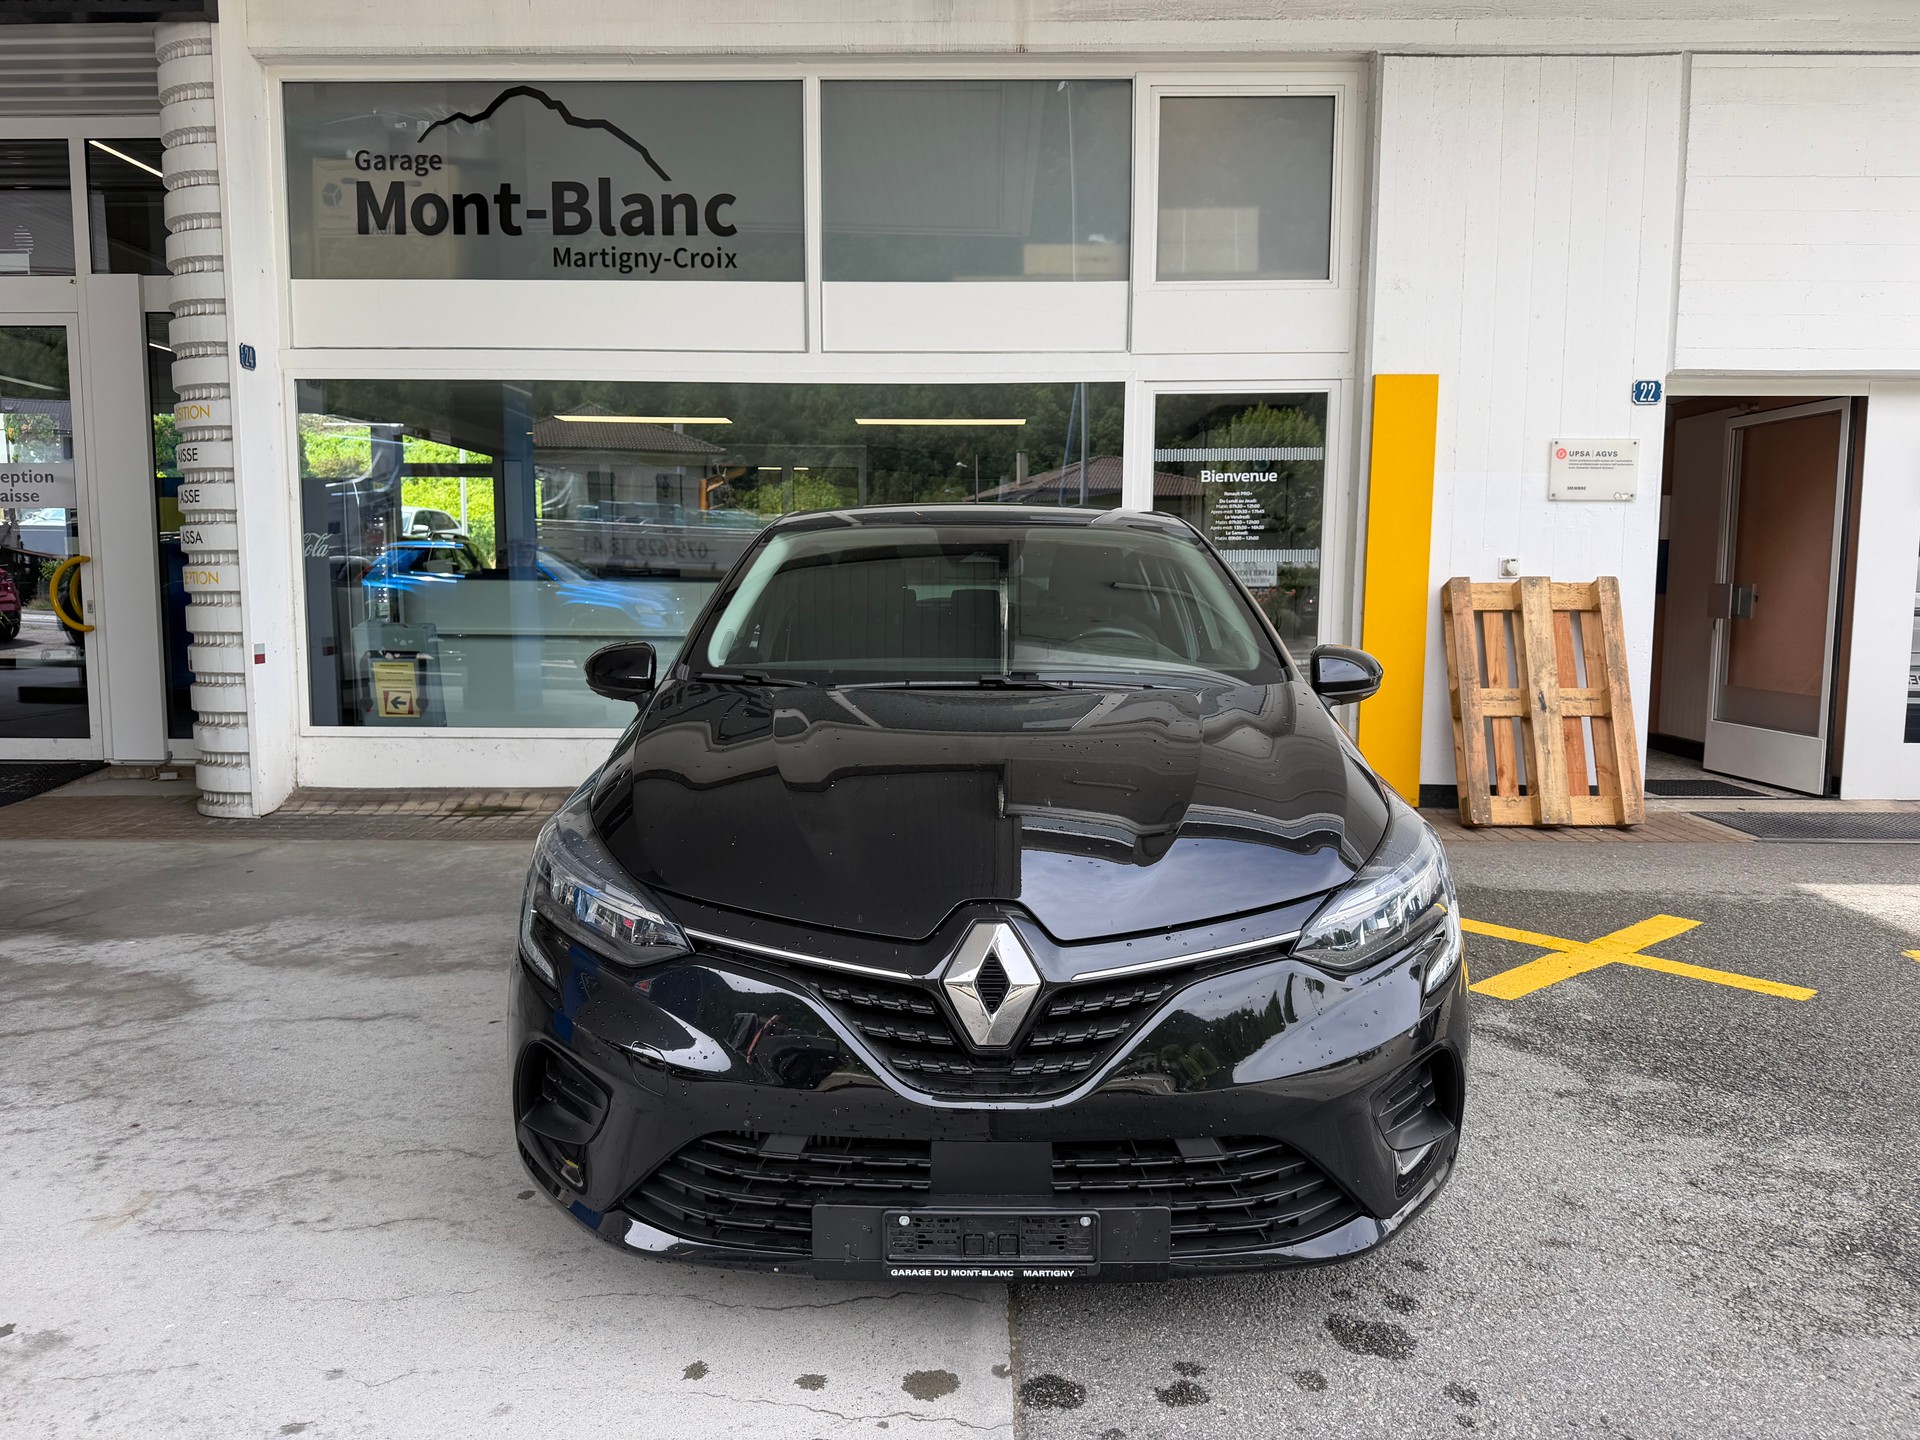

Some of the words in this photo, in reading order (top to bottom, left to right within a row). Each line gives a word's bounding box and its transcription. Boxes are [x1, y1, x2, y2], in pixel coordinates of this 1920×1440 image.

[354, 149, 443, 176] Garage
[355, 177, 738, 238] Mont-Blanc
[553, 246, 738, 273] Martigny-Croix
[1640, 382, 1656, 401] 22
[0, 469, 54, 487] eption
[1201, 470, 1278, 482] Bienvenue
[0, 488, 40, 502] aisse
[890, 1269, 931, 1277] GARAGE
[934, 1269, 948, 1277] DU
[951, 1269, 1014, 1277] MONT-BLANC
[1023, 1269, 1075, 1277] MARTIGNY
